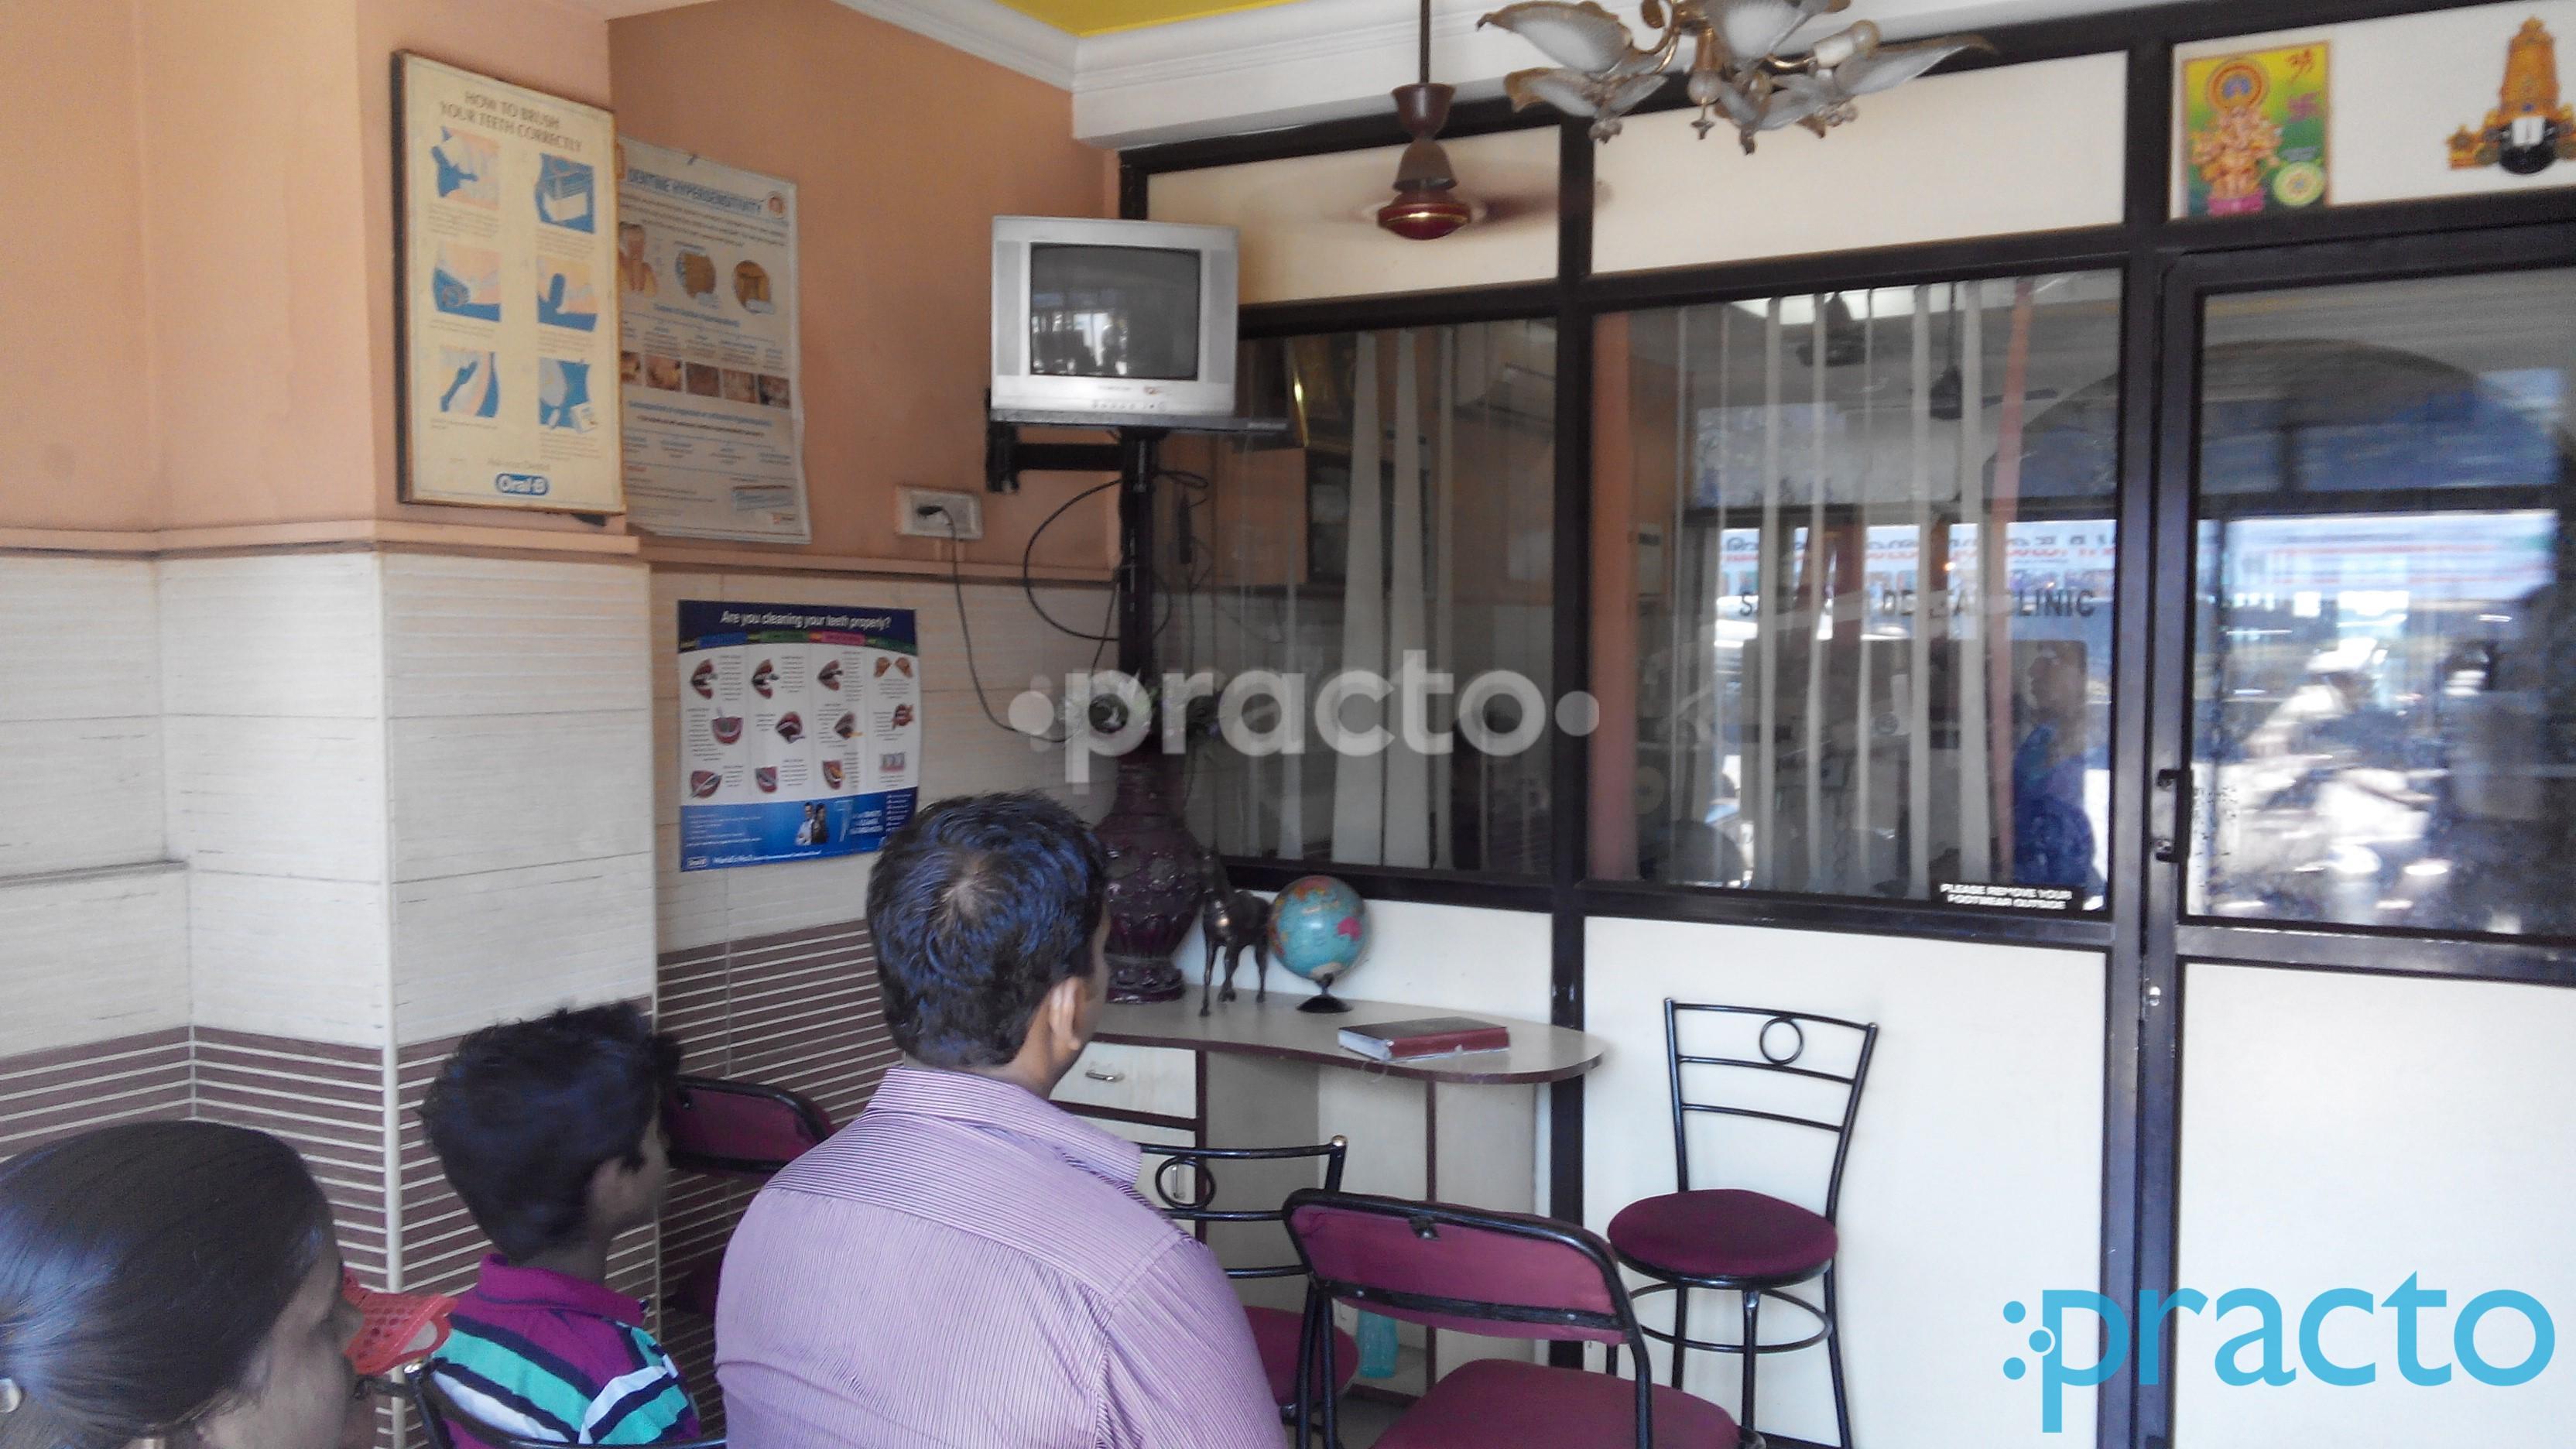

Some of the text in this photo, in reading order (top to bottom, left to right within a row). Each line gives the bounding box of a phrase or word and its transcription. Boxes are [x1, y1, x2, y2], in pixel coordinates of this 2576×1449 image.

[464, 91, 559, 128] HOW TO BRUSH
[440, 101, 582, 152] YOUR TEETH CORRECTLY
[721, 610, 740, 624] Are
[740, 613, 761, 626] you
[762, 612, 803, 629] cleaning
[803, 615, 825, 629] your
[826, 615, 849, 627] teeth
[1940, 883, 1986, 895] PLEASE
